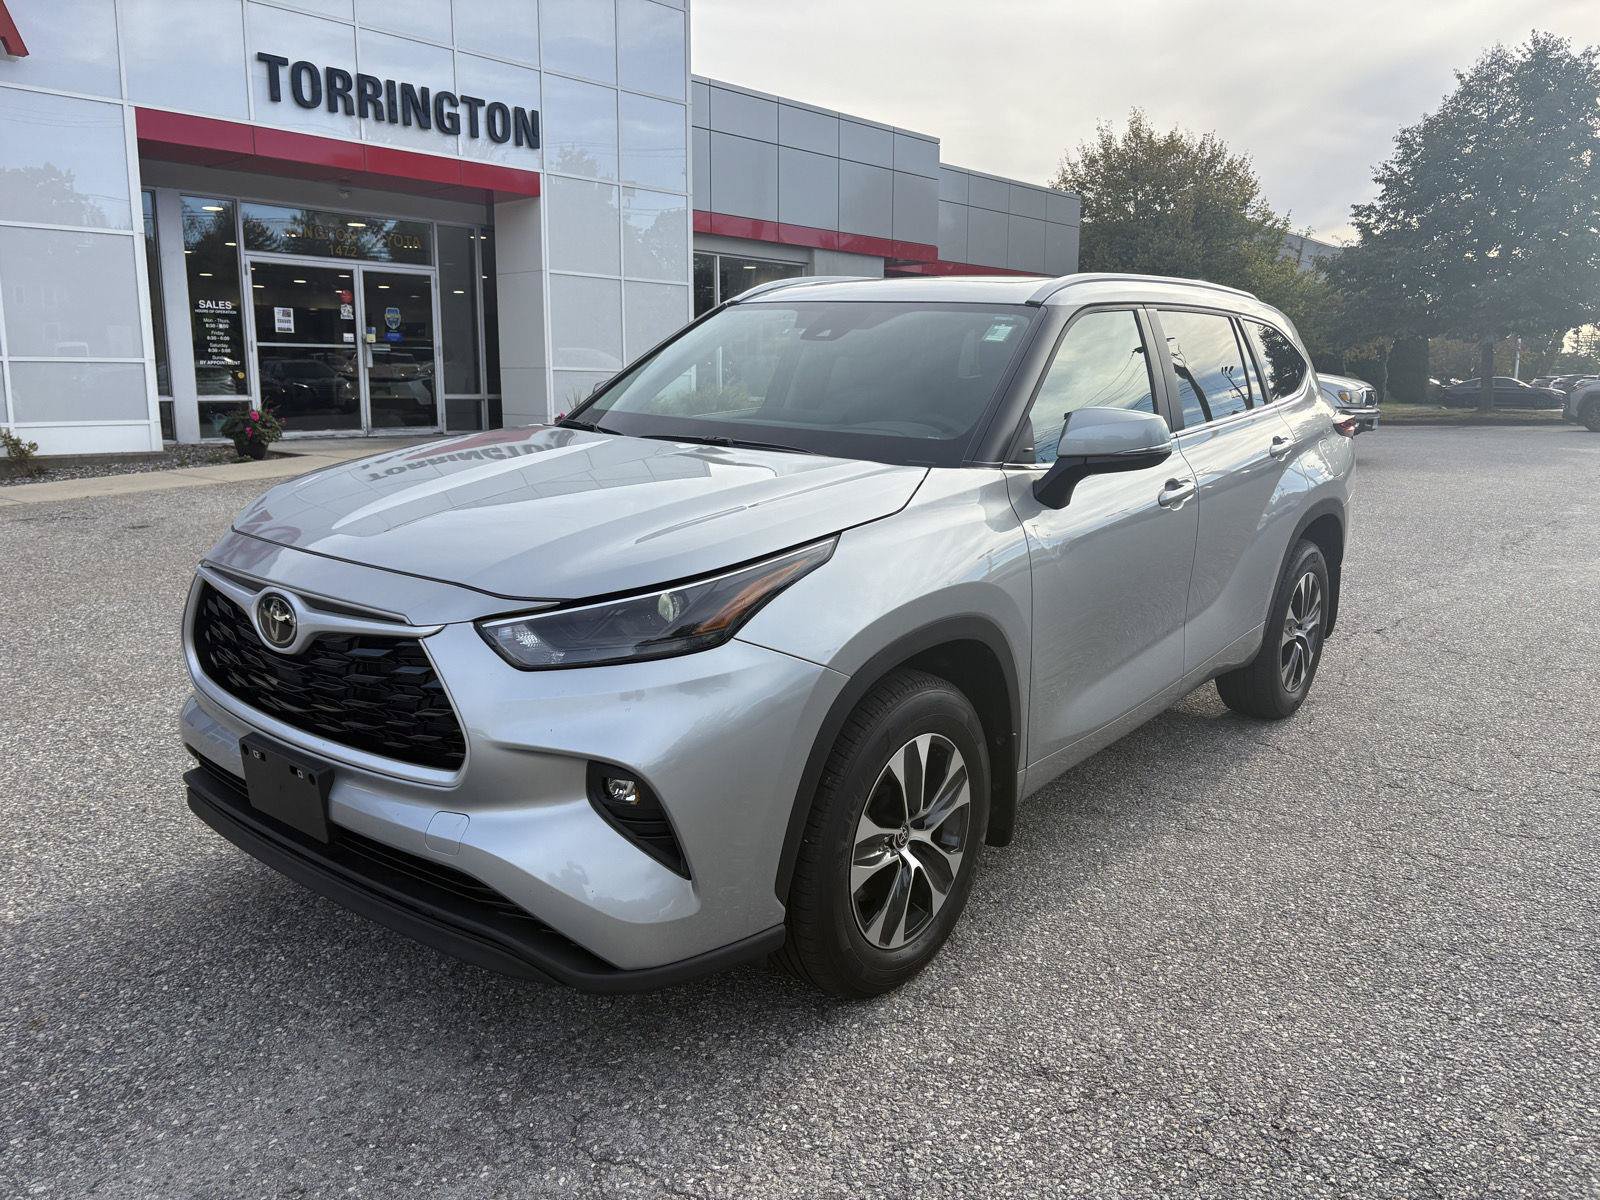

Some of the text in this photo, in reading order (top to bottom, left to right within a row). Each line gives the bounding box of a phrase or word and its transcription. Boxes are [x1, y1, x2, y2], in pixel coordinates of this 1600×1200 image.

[257, 52, 540, 149] TORRINGTON
[328, 244, 358, 257] 1472
[198, 300, 232, 310] SALES
